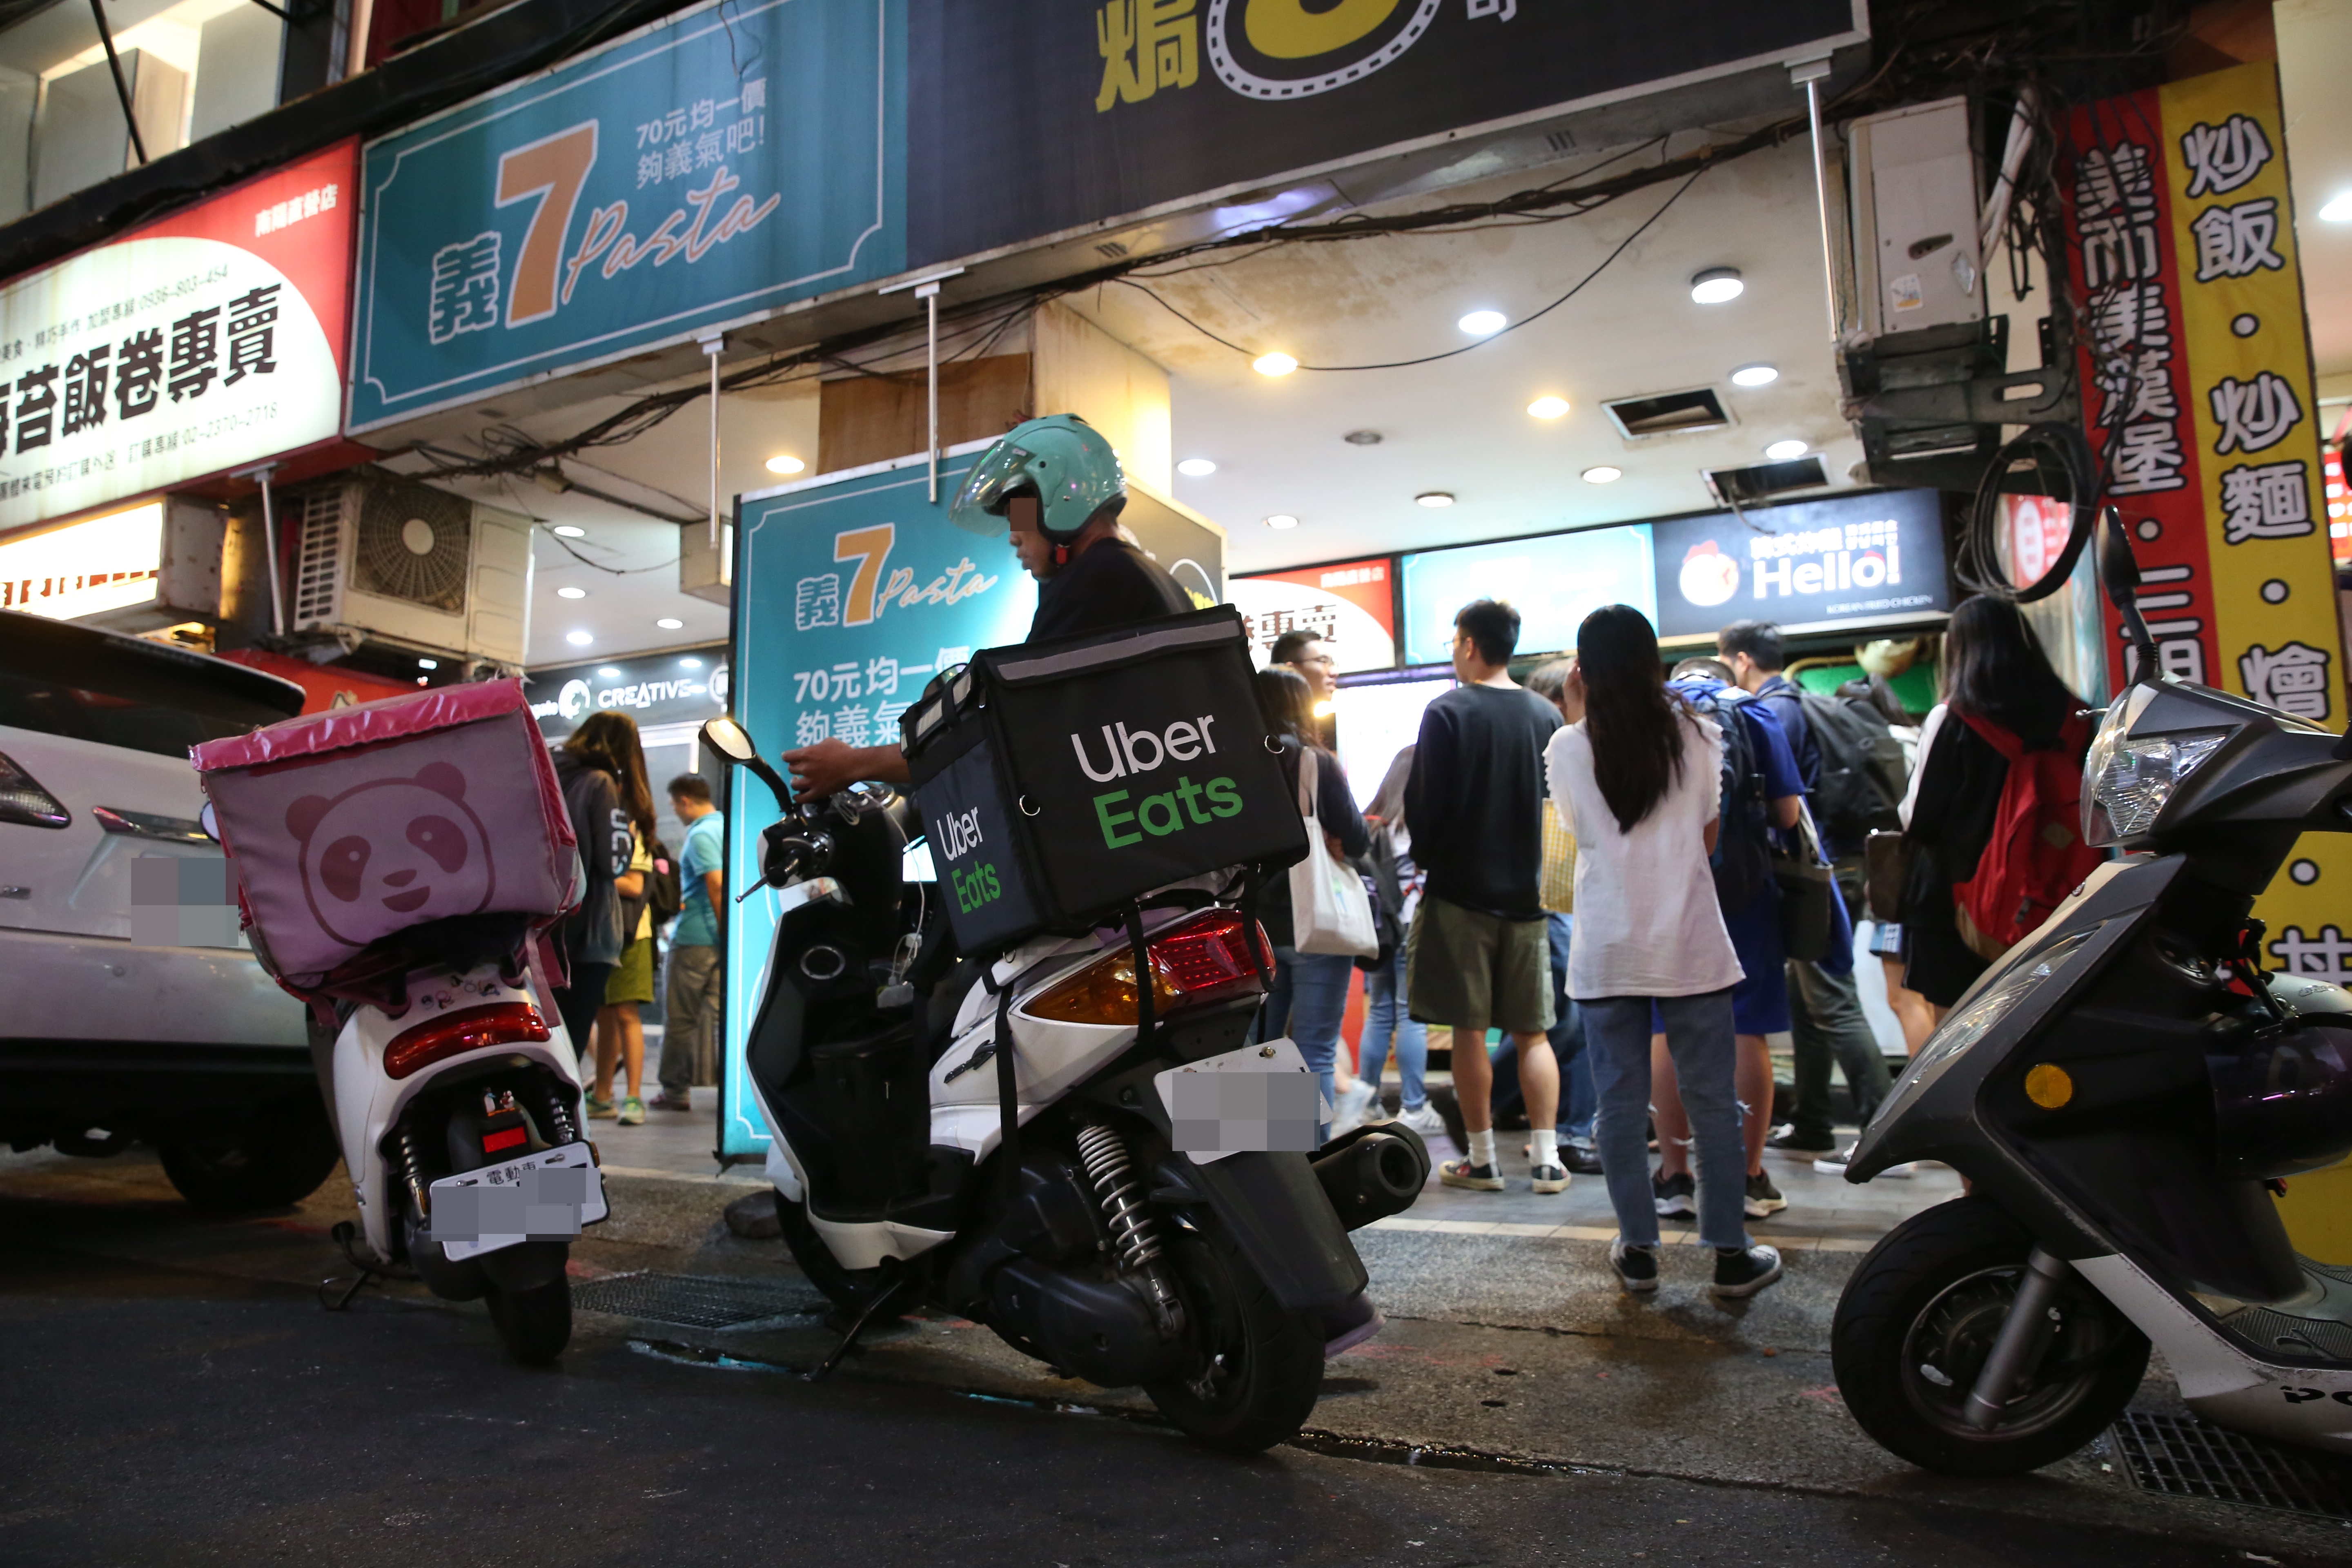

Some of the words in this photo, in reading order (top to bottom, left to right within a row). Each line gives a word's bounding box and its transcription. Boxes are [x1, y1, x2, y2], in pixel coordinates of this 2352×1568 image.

[636, 78, 767, 149] 70元均一價
[636, 114, 765, 189] 夠義氣吧!
[561, 165, 781, 305] Pasta
[0, 283, 282, 463] 苔飯卷專賣
[876, 557, 998, 618] Pasta
[1753, 545, 1901, 599] Hello!
[598, 677, 693, 709] CREATIVE
[1071, 715, 1216, 782] Uber
[936, 806, 983, 861] Uber
[1093, 776, 1243, 850] Eats
[951, 860, 1001, 914] Eats
